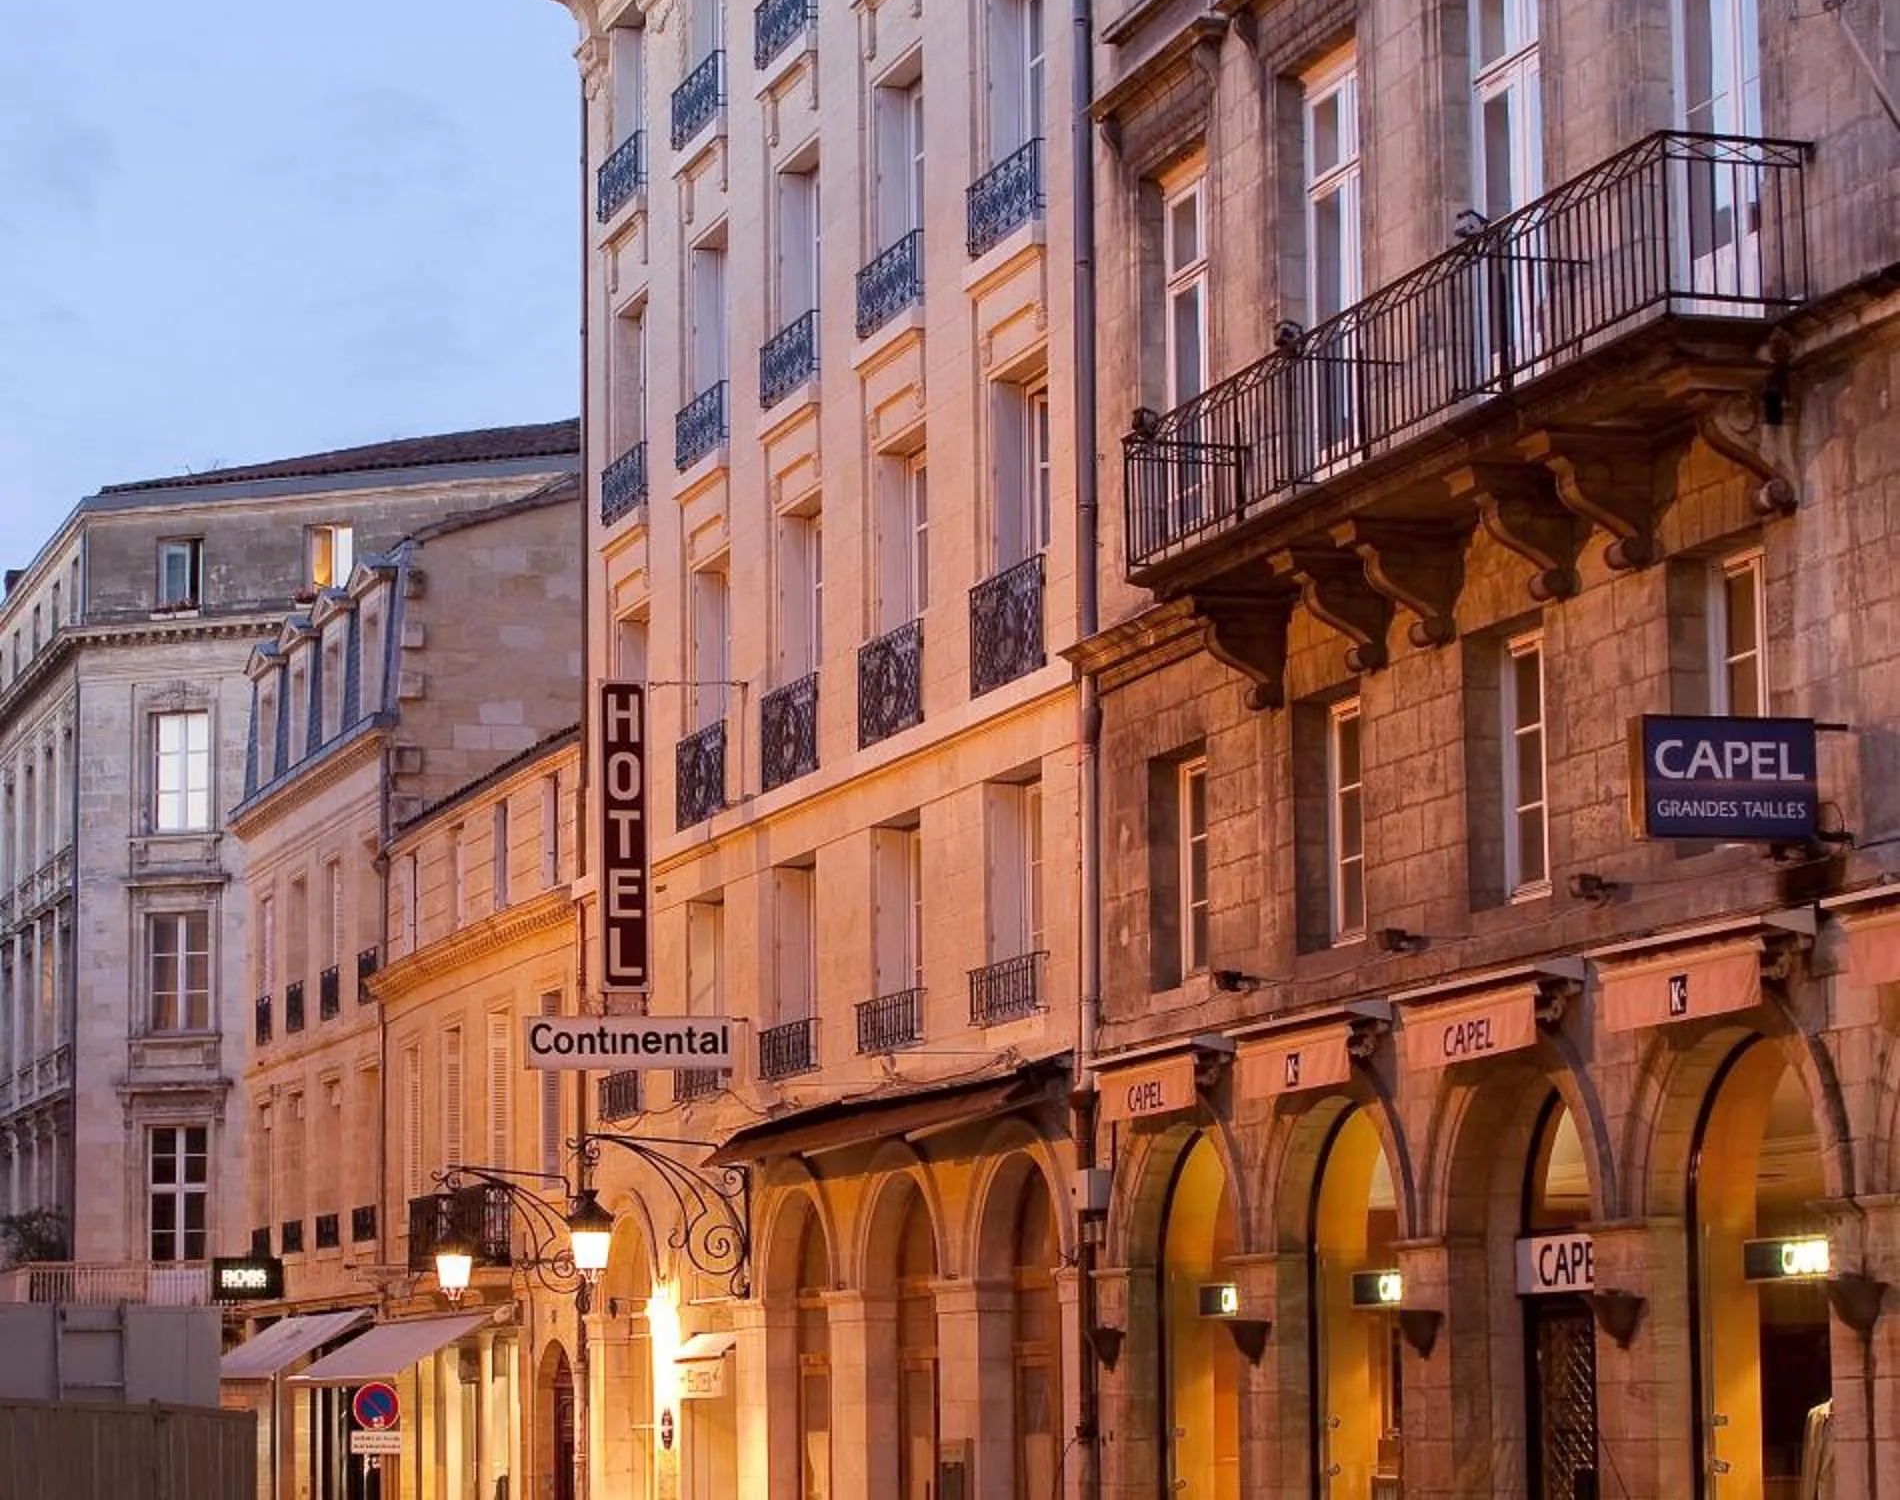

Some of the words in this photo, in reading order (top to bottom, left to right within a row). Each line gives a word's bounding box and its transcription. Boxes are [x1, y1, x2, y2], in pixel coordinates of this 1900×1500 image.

[1654, 739, 1805, 781] CAPEL
[1657, 799, 1738, 818] GRANDES
[1742, 800, 1807, 819] TAILLES
[607, 693, 643, 977] HOTEL
[530, 1022, 729, 1055] Continental
[1443, 1018, 1494, 1057] CAPEL
[1127, 1081, 1165, 1112] CAPEL
